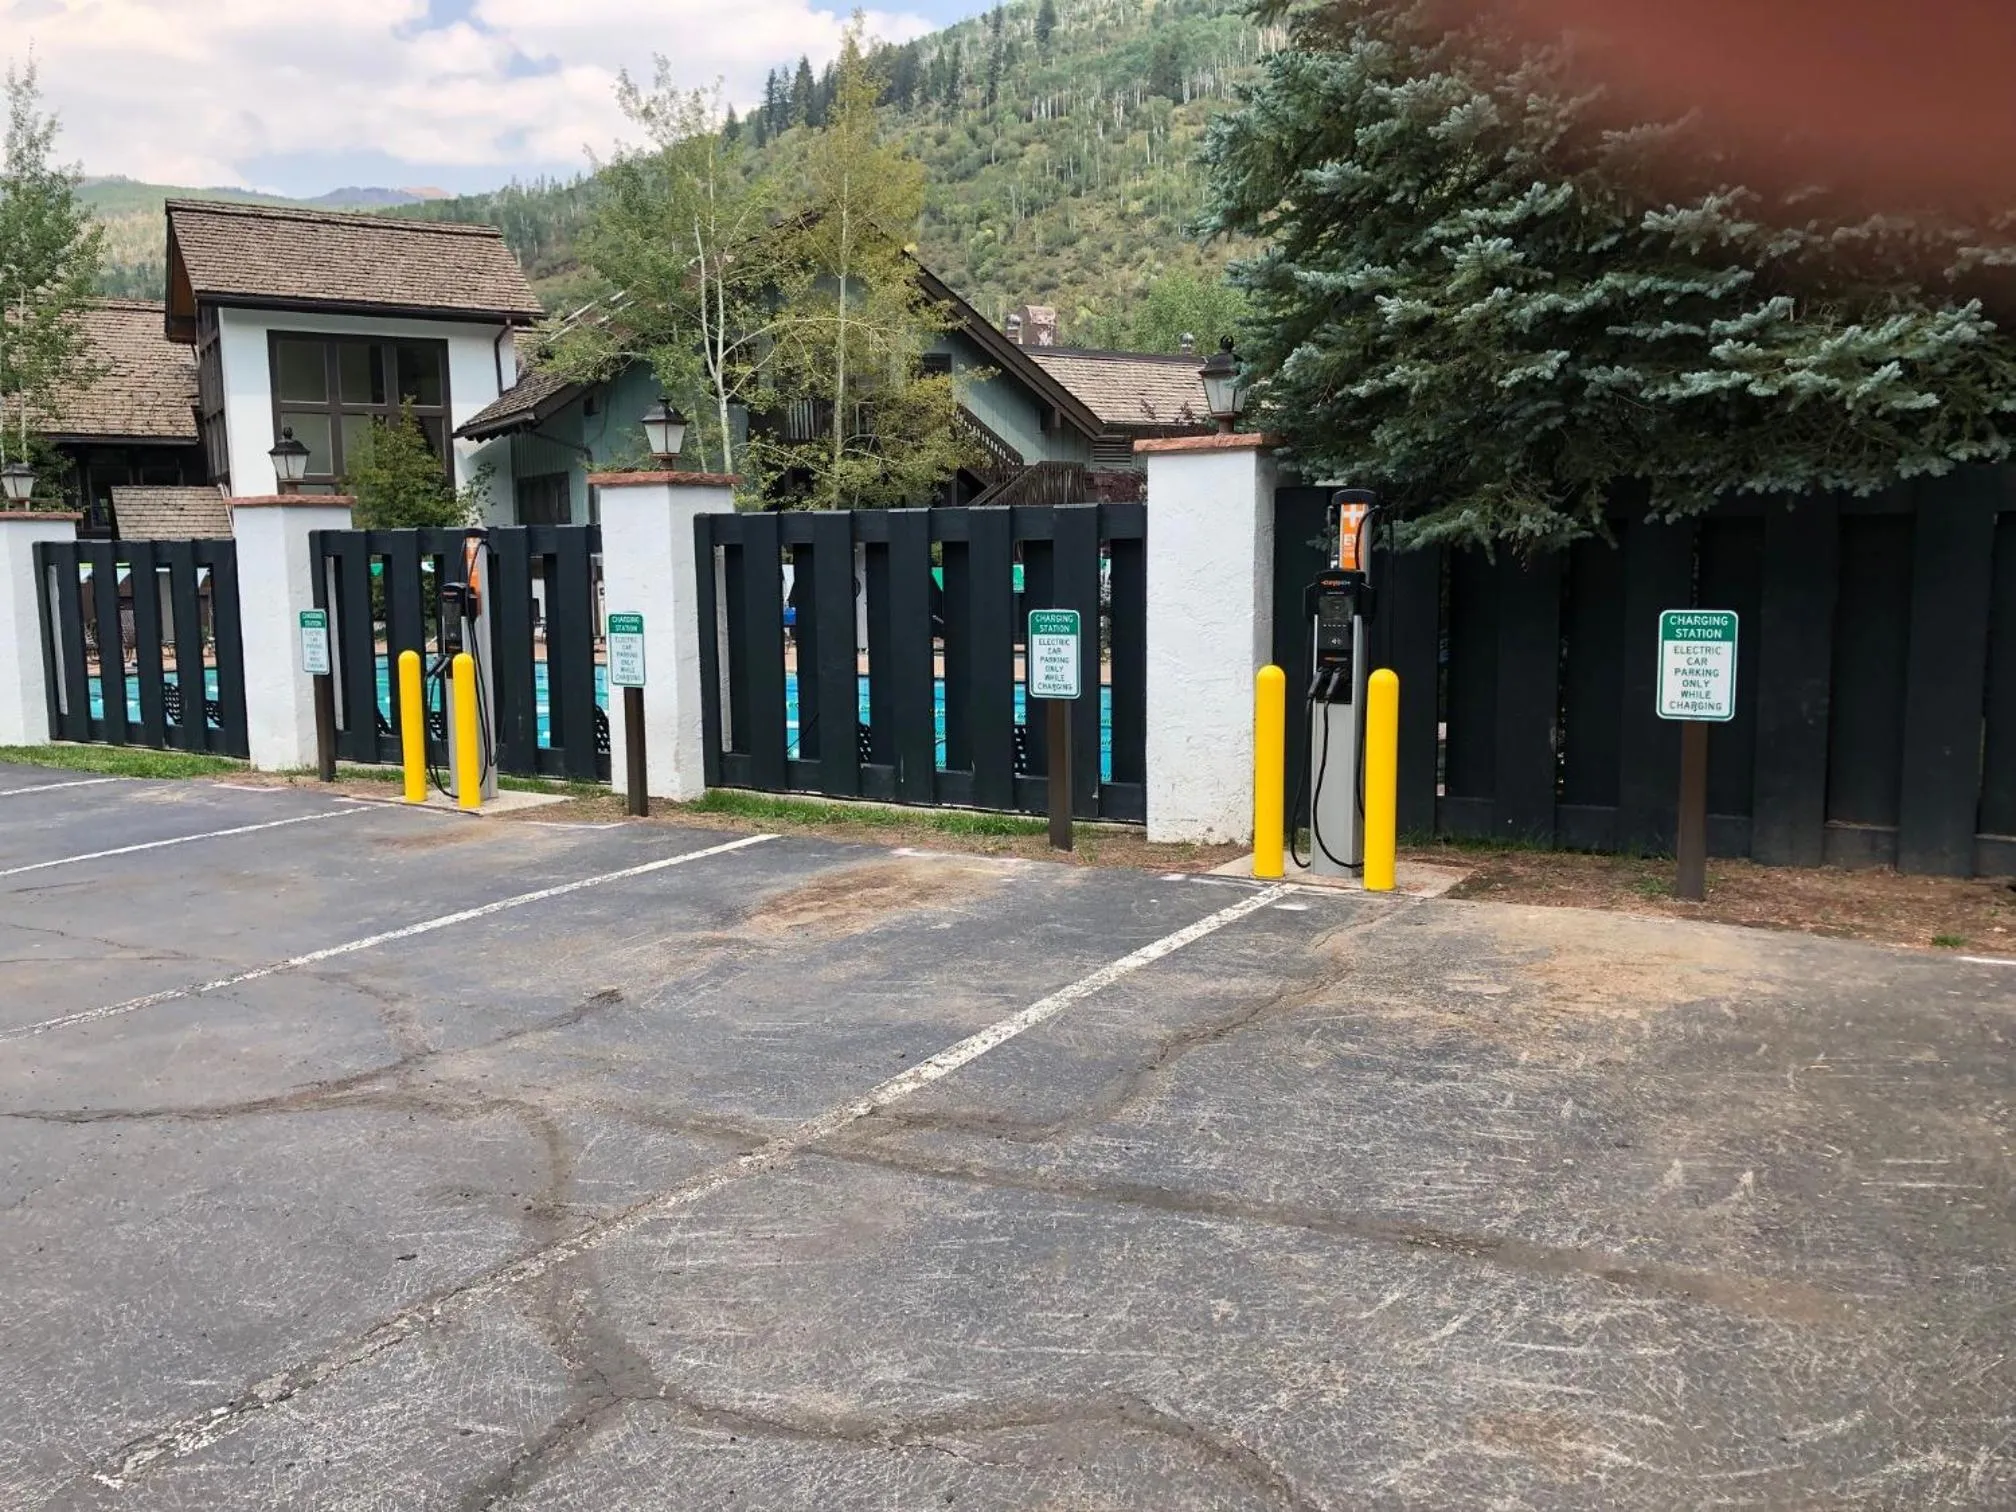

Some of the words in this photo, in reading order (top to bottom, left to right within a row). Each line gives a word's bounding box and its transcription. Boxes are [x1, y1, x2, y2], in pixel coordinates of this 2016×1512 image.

[1035, 614, 1073, 623] CHARGING
[1669, 615, 1728, 626] CHARGING
[1039, 624, 1070, 633] STATION
[1675, 628, 1722, 639] STATION
[1038, 638, 1070, 646] ELECTRIC
[1673, 645, 1722, 655] ELECTRIC
[1686, 657, 1708, 666] CAR
[1674, 667, 1720, 678] PARKING
[1044, 674, 1065, 682] WHILE
[1682, 679, 1710, 688] ONLY
[1680, 690, 1712, 700] WHILE
[1669, 701, 1723, 711] CHARGING
